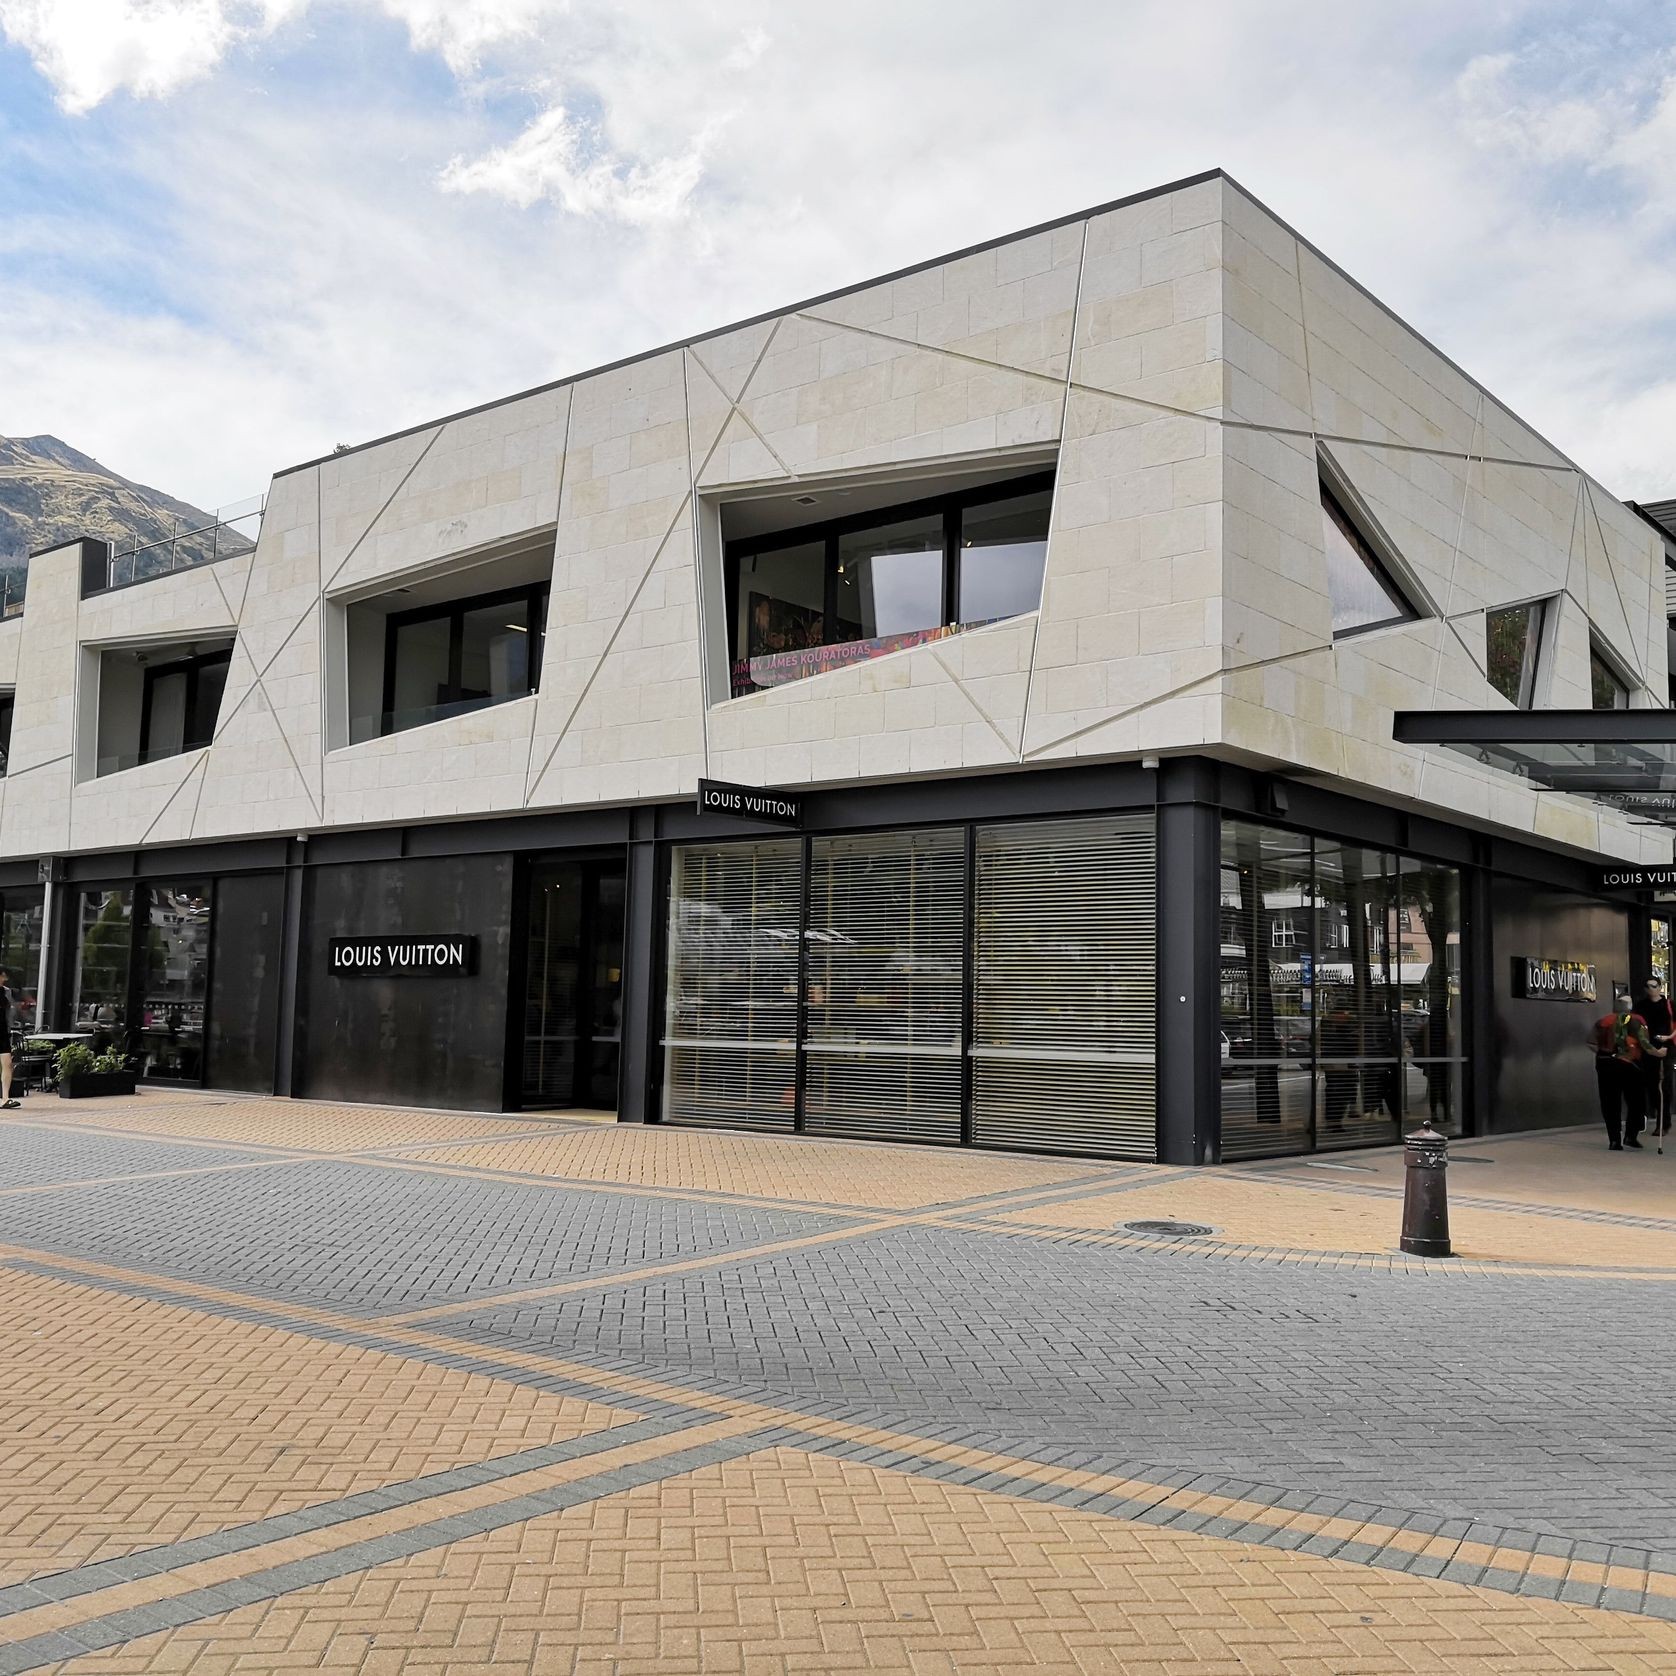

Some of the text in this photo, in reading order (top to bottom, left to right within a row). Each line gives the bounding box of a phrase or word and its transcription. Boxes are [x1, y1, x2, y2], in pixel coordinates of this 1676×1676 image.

[733, 644, 871, 675] JIMMY JAMES KOURATORAS
[705, 790, 796, 817] LOUIS VUITTON
[1603, 873, 1643, 885] LOUIS
[335, 943, 463, 966] LOUIS VUITTON
[1529, 967, 1596, 993] LOUIS VUITTON
